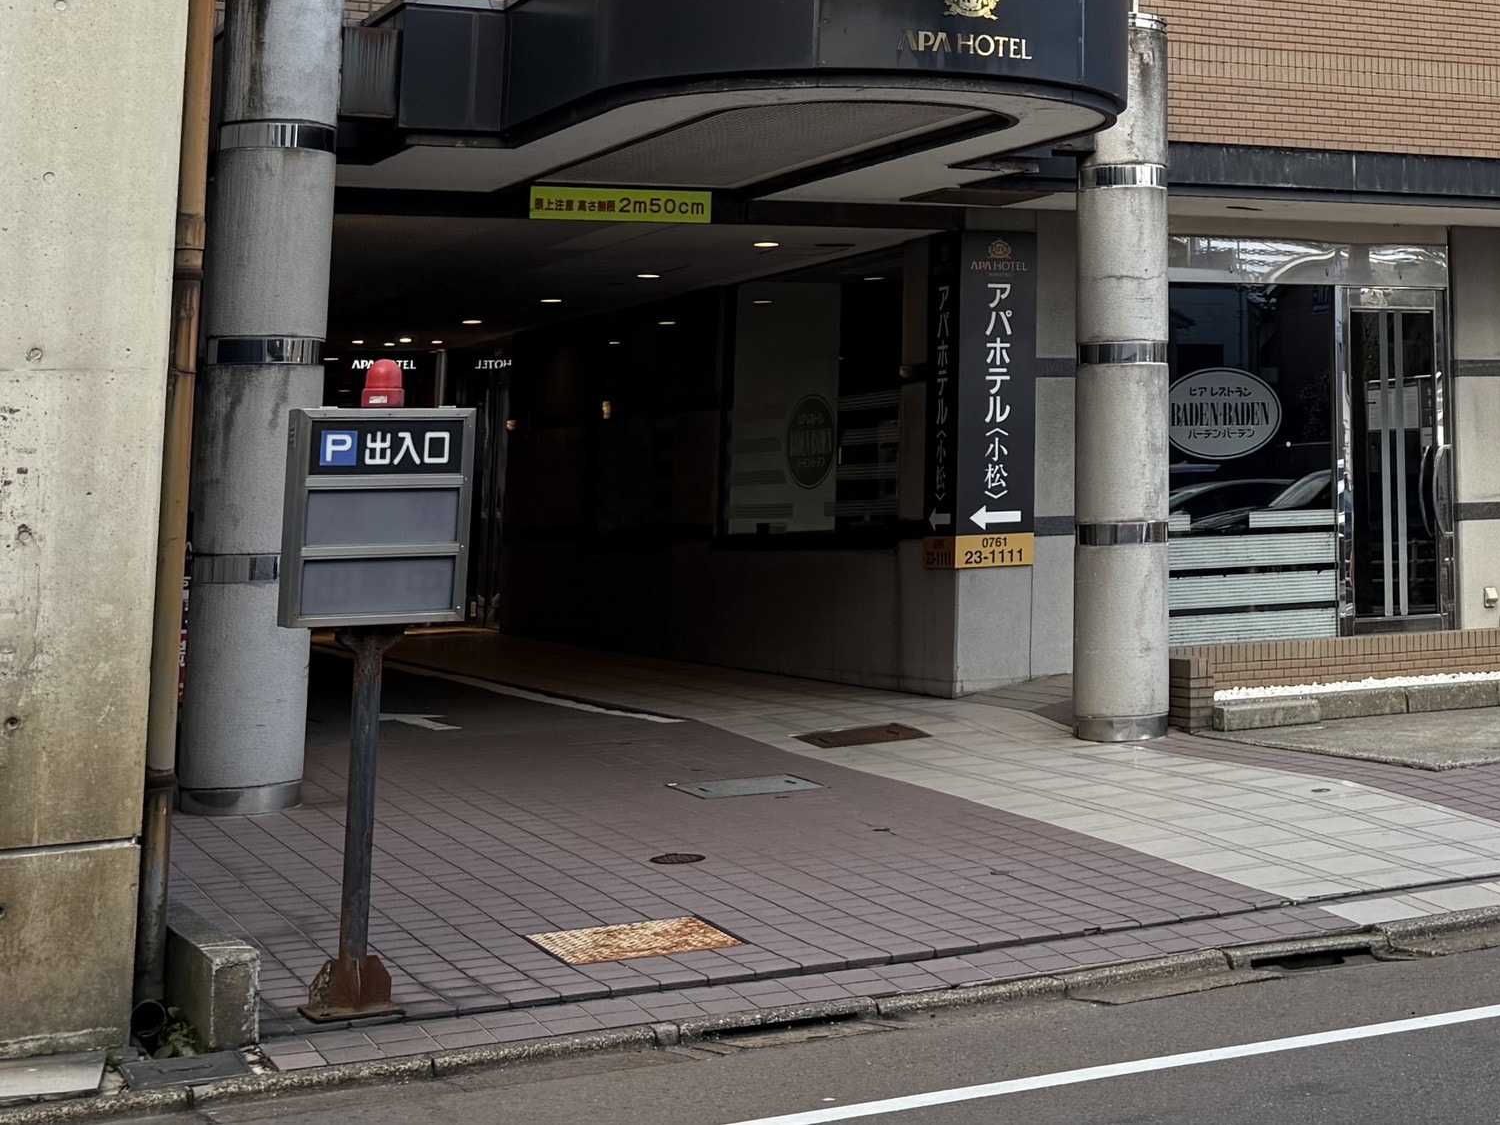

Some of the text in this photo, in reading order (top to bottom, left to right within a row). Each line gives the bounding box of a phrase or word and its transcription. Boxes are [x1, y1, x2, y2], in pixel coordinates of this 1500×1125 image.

[897, 30, 1033, 60] APA HOTEL
[618, 196, 705, 216] 2m50cm
[970, 261, 1028, 271] APA HOTEL
[1210, 386, 1252, 398] レストラン
[364, 431, 450, 465] 出入口
[981, 537, 1008, 548] 0761
[964, 548, 1024, 565] 23-1111
